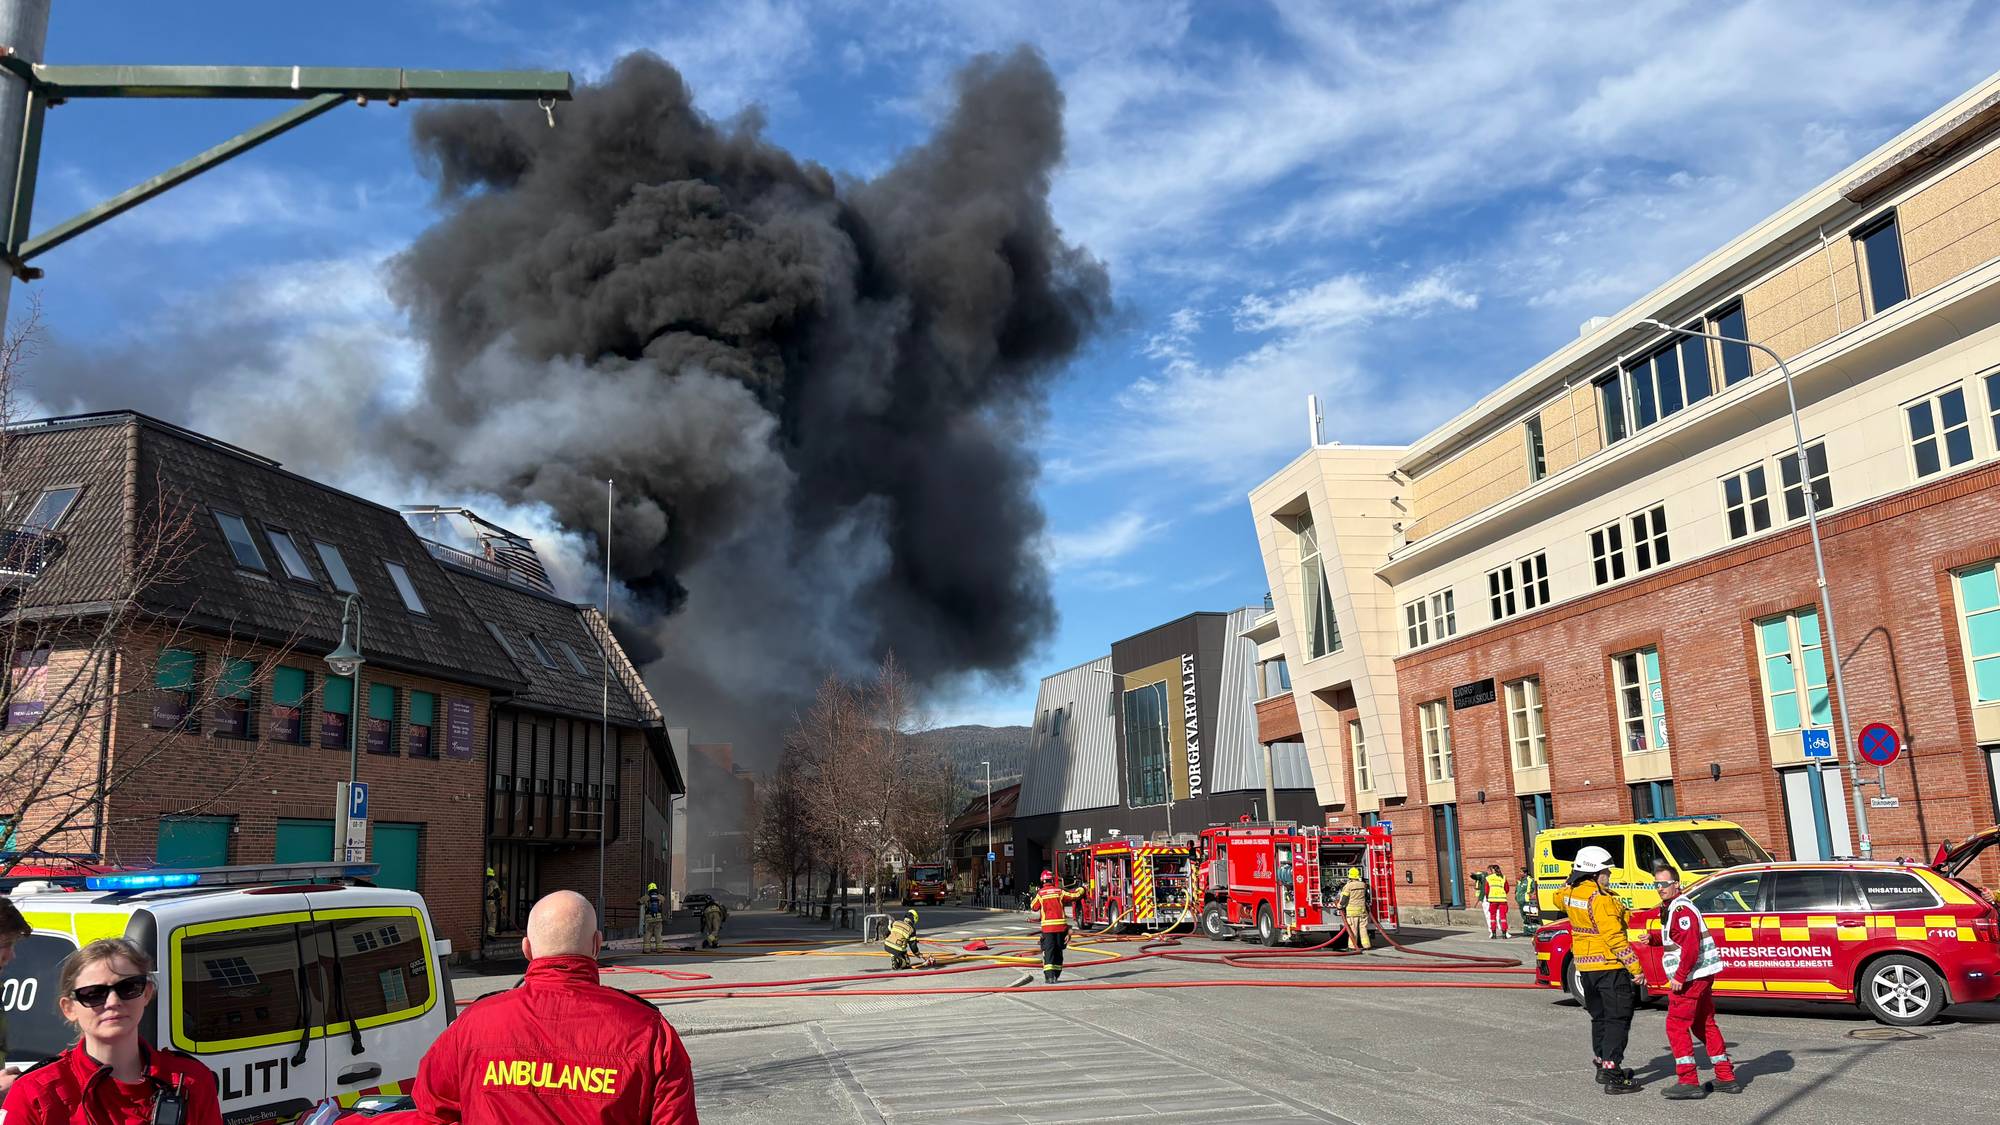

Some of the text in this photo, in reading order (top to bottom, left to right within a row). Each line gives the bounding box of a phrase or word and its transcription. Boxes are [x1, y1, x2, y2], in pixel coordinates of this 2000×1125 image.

[1181, 653, 1202, 799] TORGKVARTALET
[354, 787, 364, 814] P
[1937, 930, 1956, 938] 110
[1733, 960, 1747, 968] OG
[1748, 960, 1834, 968] REDNINGSTJENESTE
[213, 1057, 288, 1101] LITI
[483, 1060, 618, 1094] AMBULANSE
